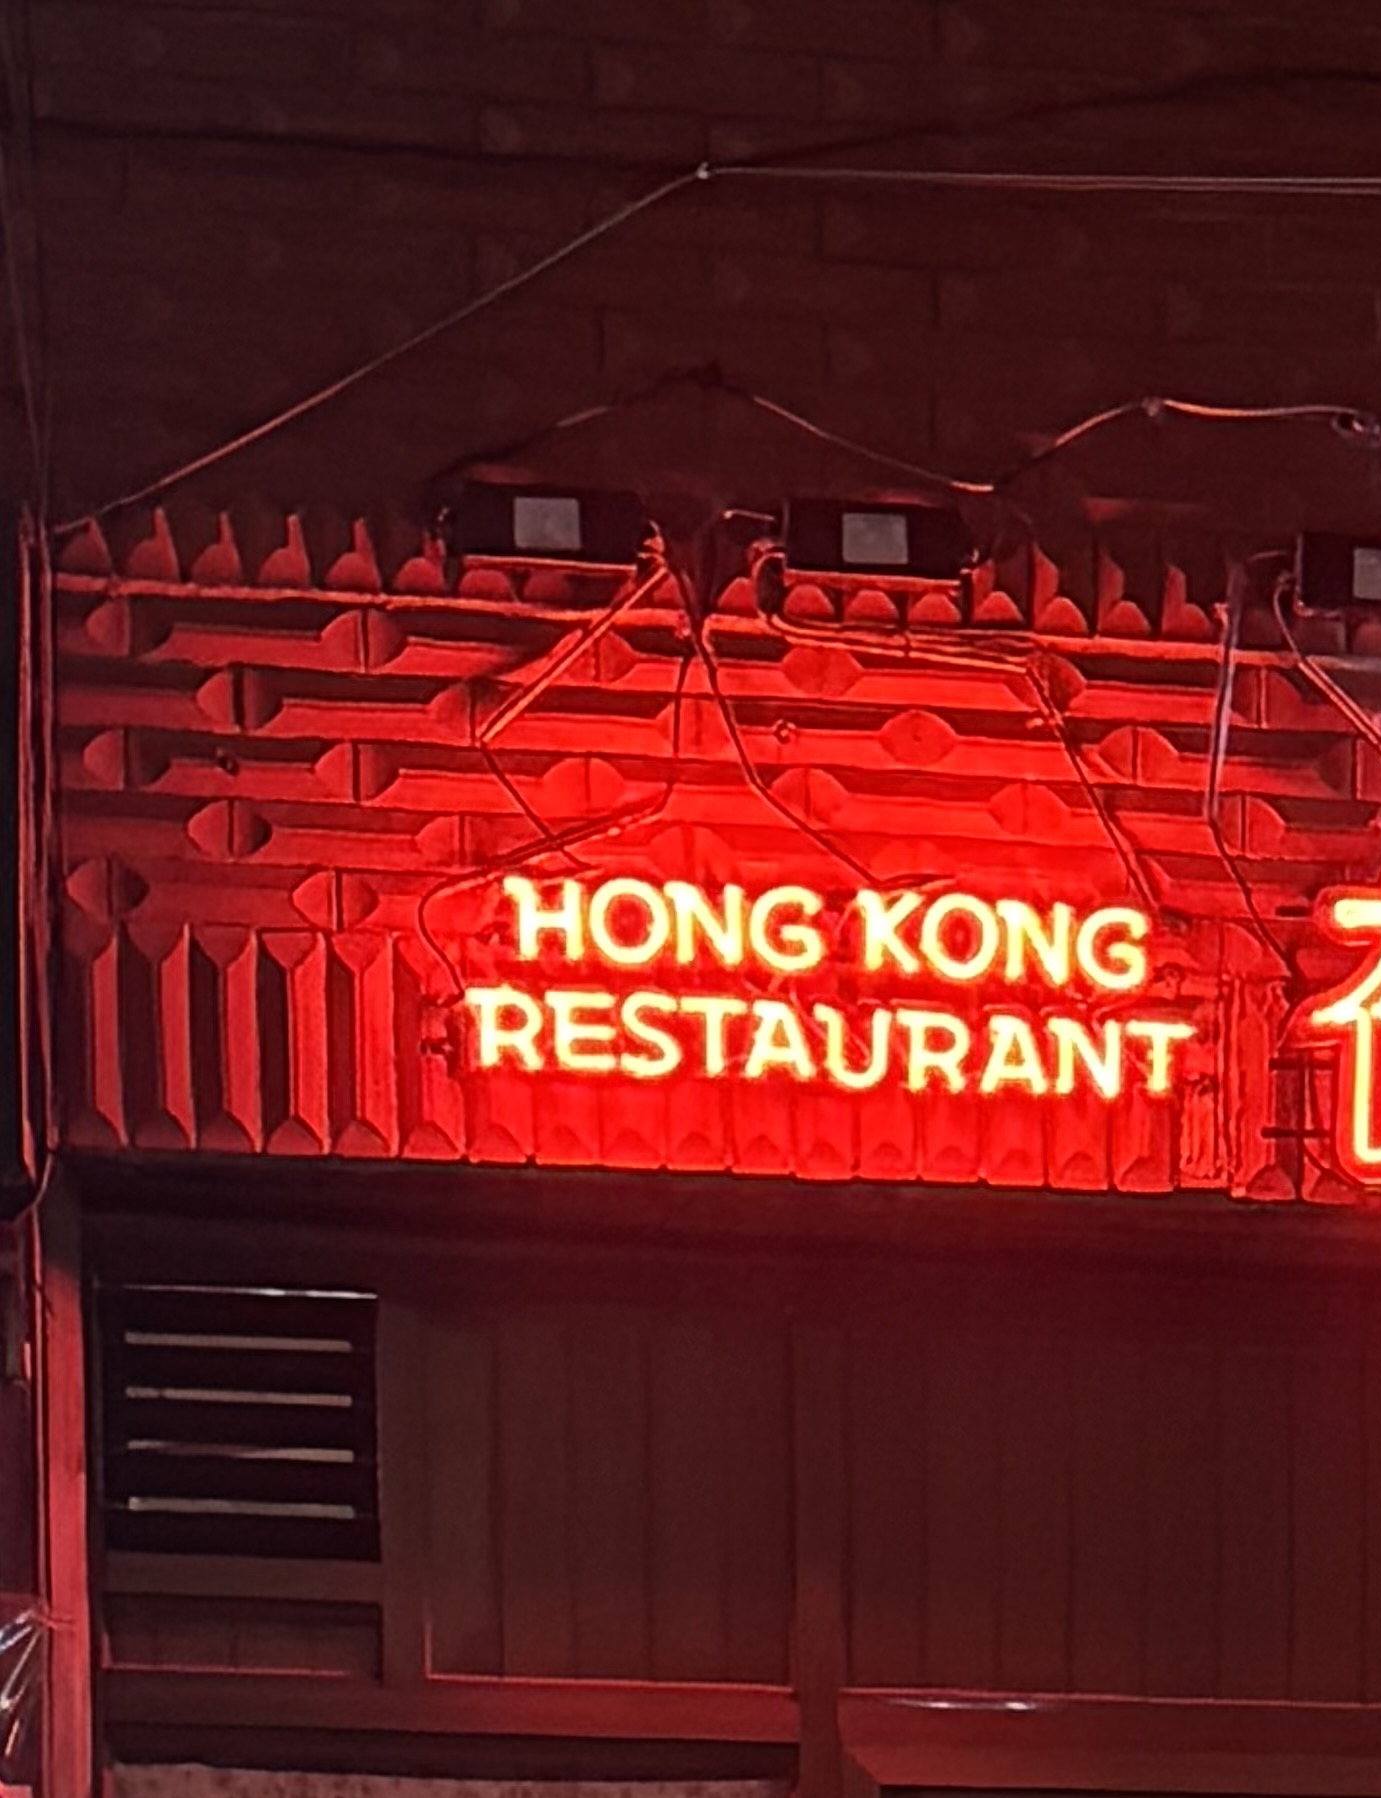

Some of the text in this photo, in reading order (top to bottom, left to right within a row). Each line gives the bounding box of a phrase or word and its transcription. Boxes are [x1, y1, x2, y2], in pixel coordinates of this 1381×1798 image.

[502, 876, 1151, 990] HONG KONG
[464, 987, 1196, 1099] RESTAURANT
